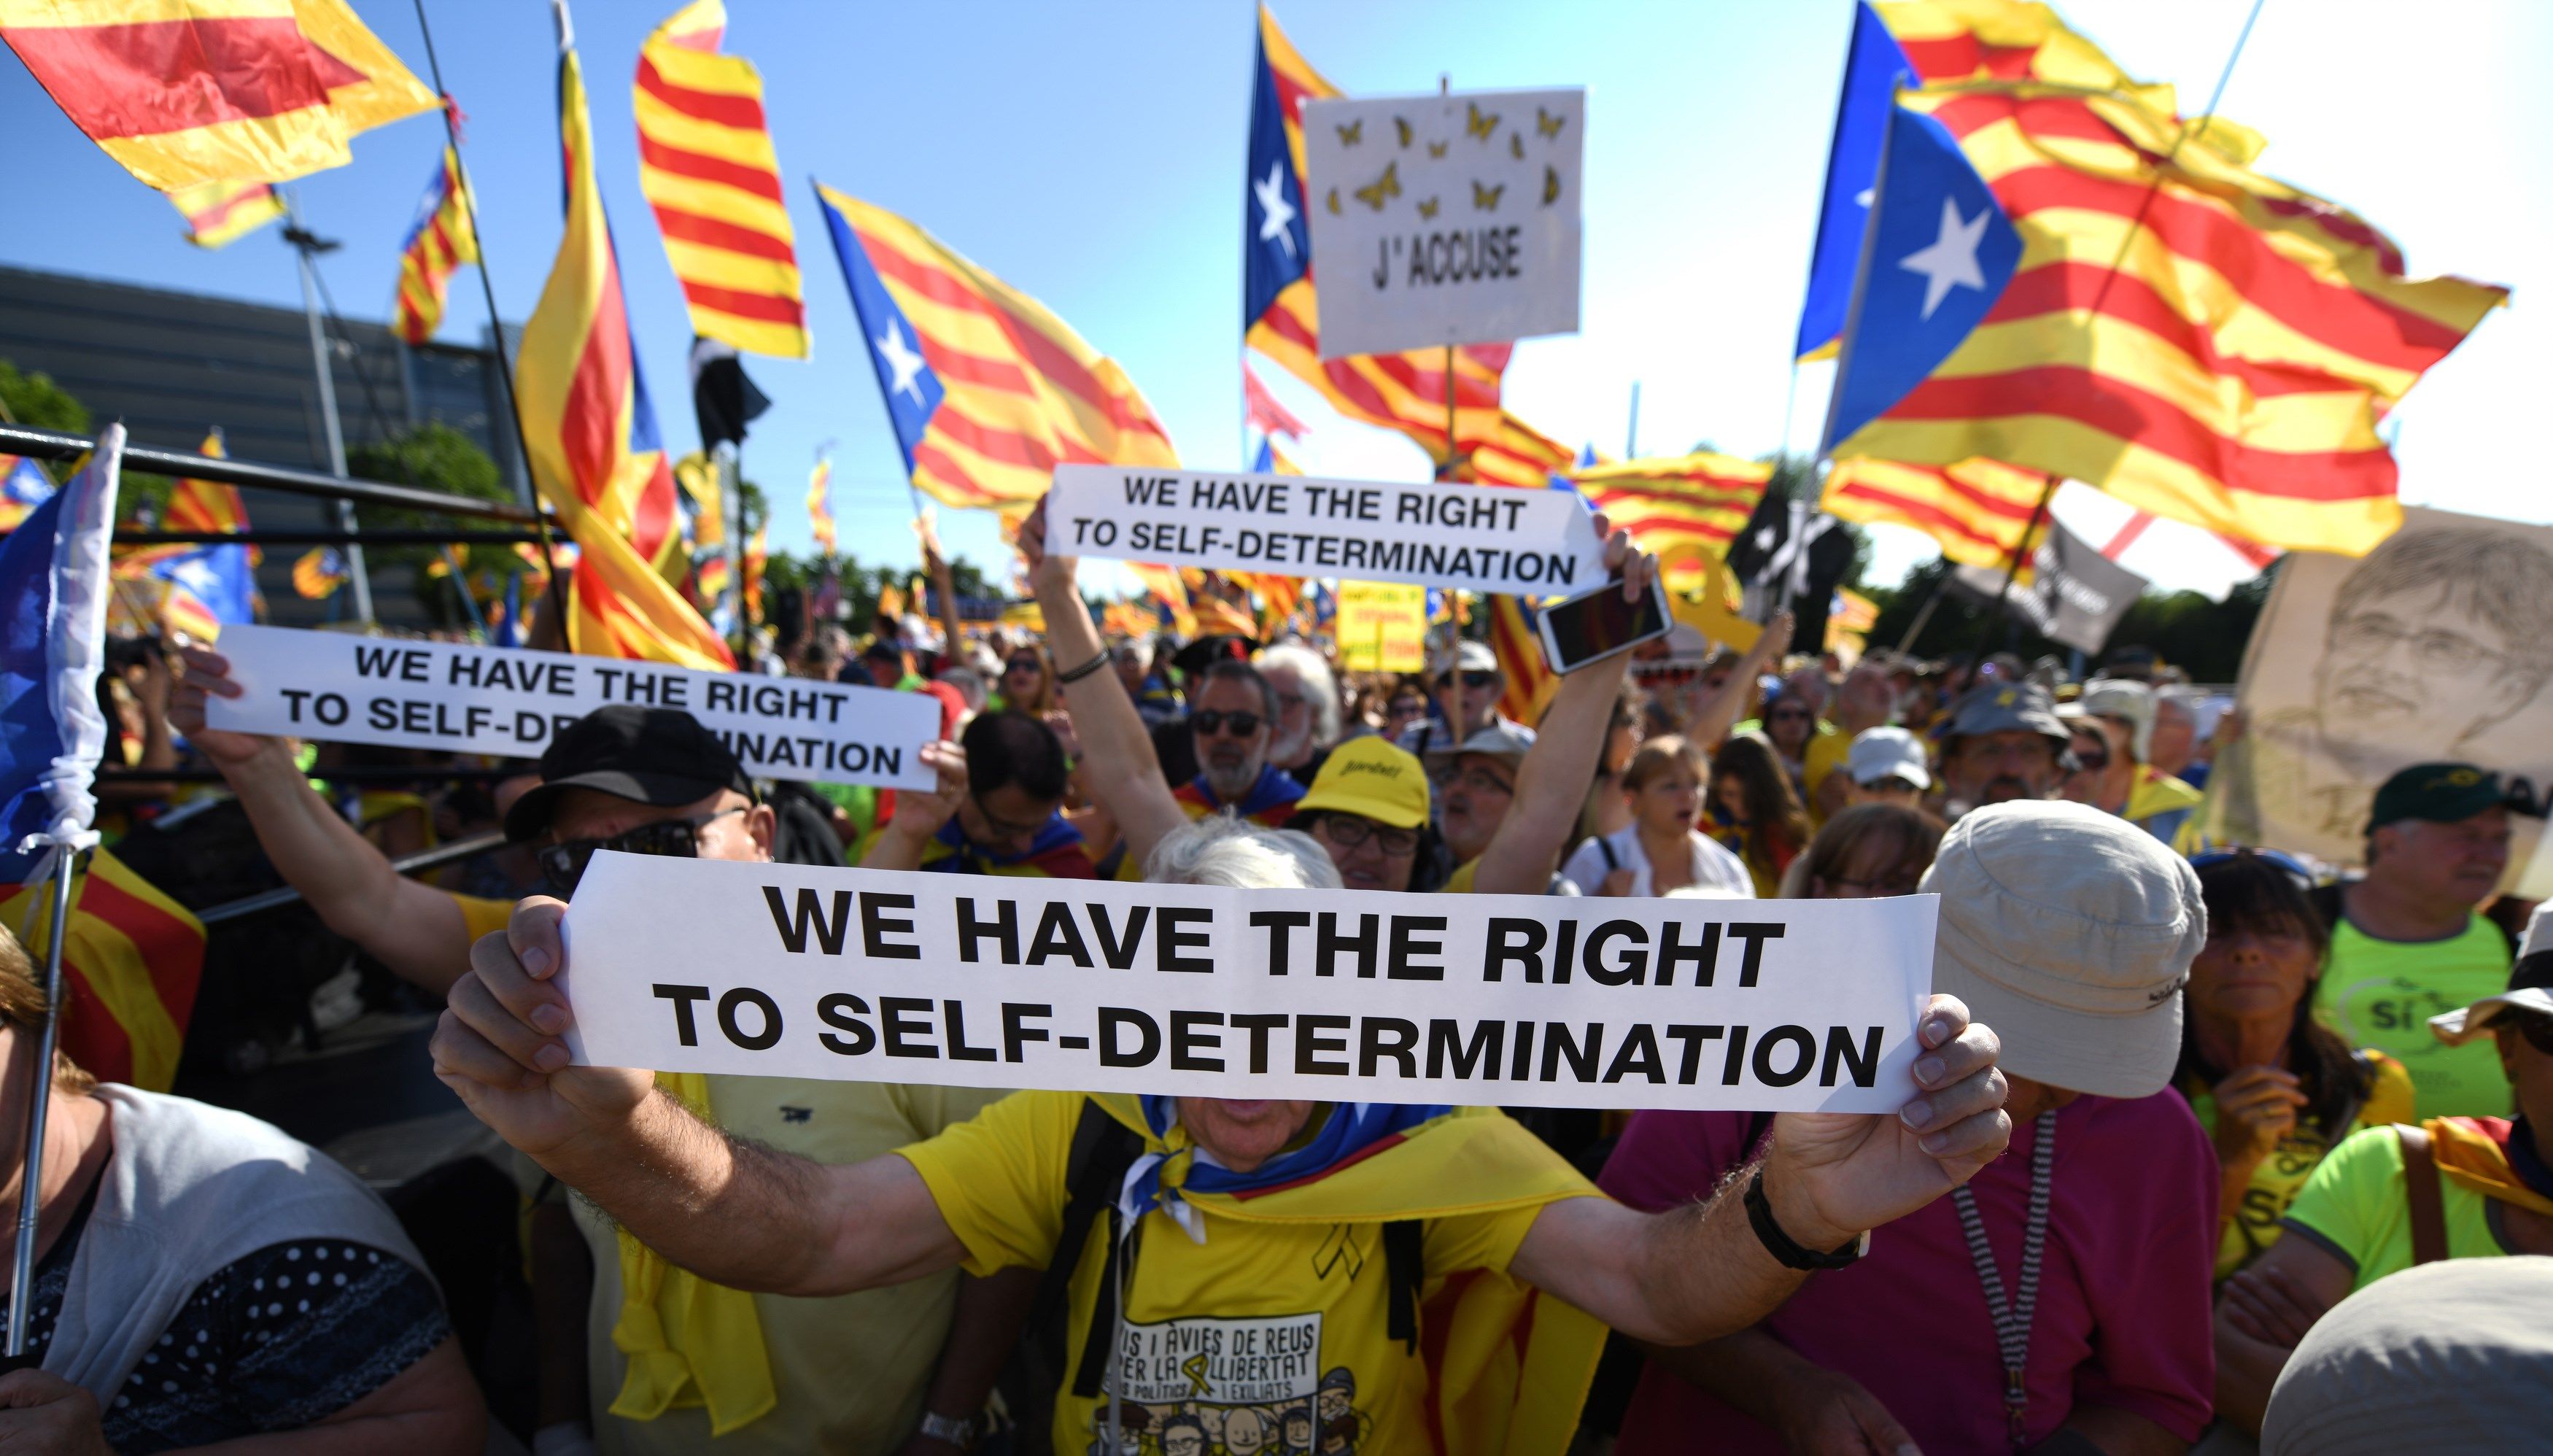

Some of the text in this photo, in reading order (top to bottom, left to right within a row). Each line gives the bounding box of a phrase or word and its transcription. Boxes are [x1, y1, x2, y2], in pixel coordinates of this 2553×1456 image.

[1373, 225, 1522, 290] J'ACCUSE
[1124, 476, 1527, 531] WE HAVE THE RIGHT
[1073, 518, 1577, 585] TO SELF-DETERMINATION
[280, 689, 349, 727] TO
[355, 646, 848, 723] WE HAVE THE RIGHT
[762, 886, 1786, 987] WE HAVE THE RIGHT
[652, 984, 1884, 1088] TO SELF-DETERMINATION
[1150, 1333, 1157, 1355] I
[1233, 1329, 1257, 1355] DE
[1266, 1323, 1314, 1353] REUS
[1155, 1355, 1177, 1381] LA
[1209, 1351, 1309, 1382] LLIBERTAT
